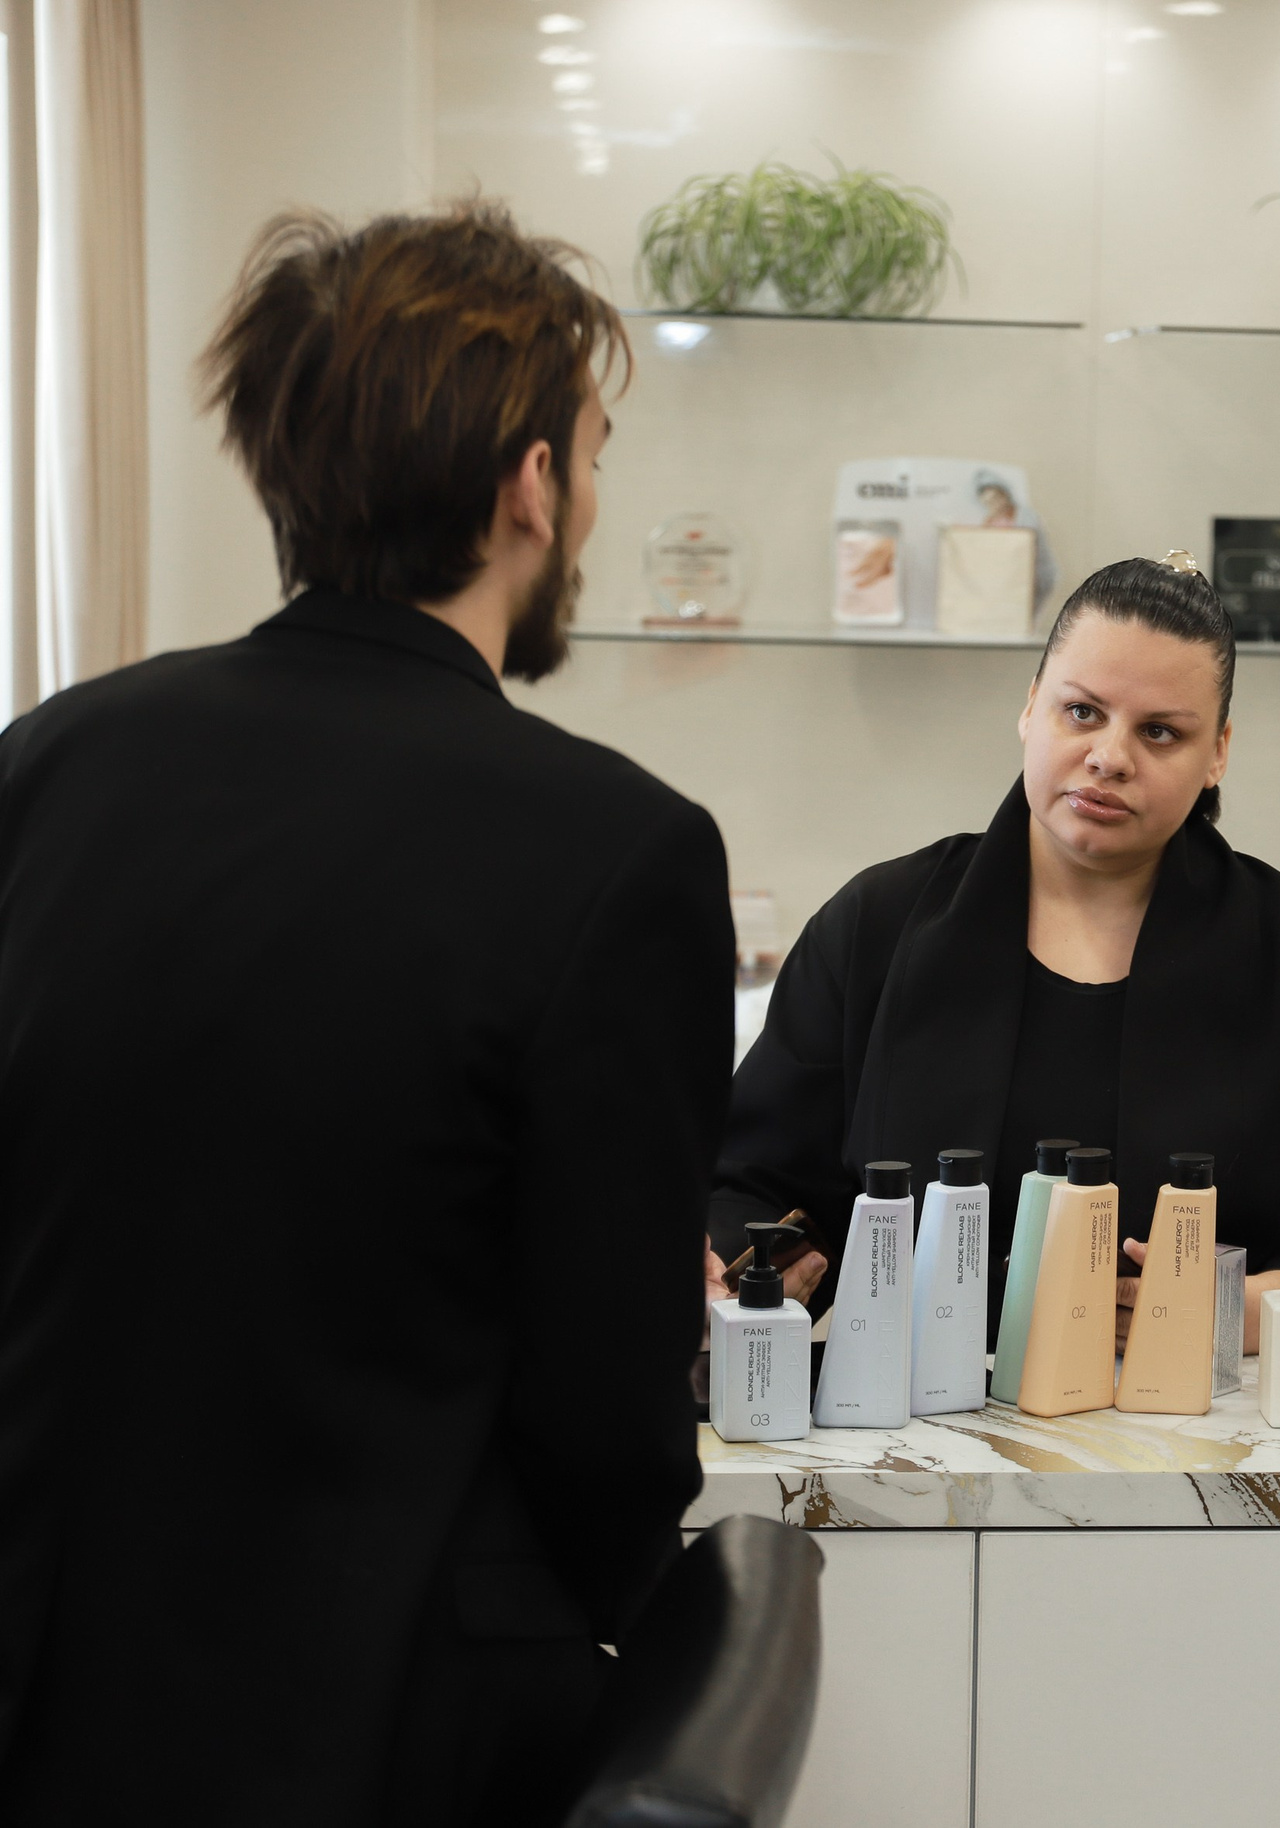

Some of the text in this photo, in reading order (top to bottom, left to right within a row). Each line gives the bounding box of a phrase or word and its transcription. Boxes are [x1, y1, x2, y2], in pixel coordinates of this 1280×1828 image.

[955, 1202, 981, 1211] FANE
[1090, 1200, 1112, 1210] FANE
[1173, 1206, 1200, 1215] FANE
[868, 1215, 897, 1224] FANE
[1175, 1218, 1183, 1254] ENERGY
[870, 1261, 878, 1298] BLONDE
[935, 1305, 953, 1319] 02
[1072, 1306, 1086, 1319] 02
[1152, 1306, 1167, 1318] 01
[850, 1319, 866, 1331] 01
[743, 1327, 772, 1336] FANE
[750, 1413, 770, 1427] 03
